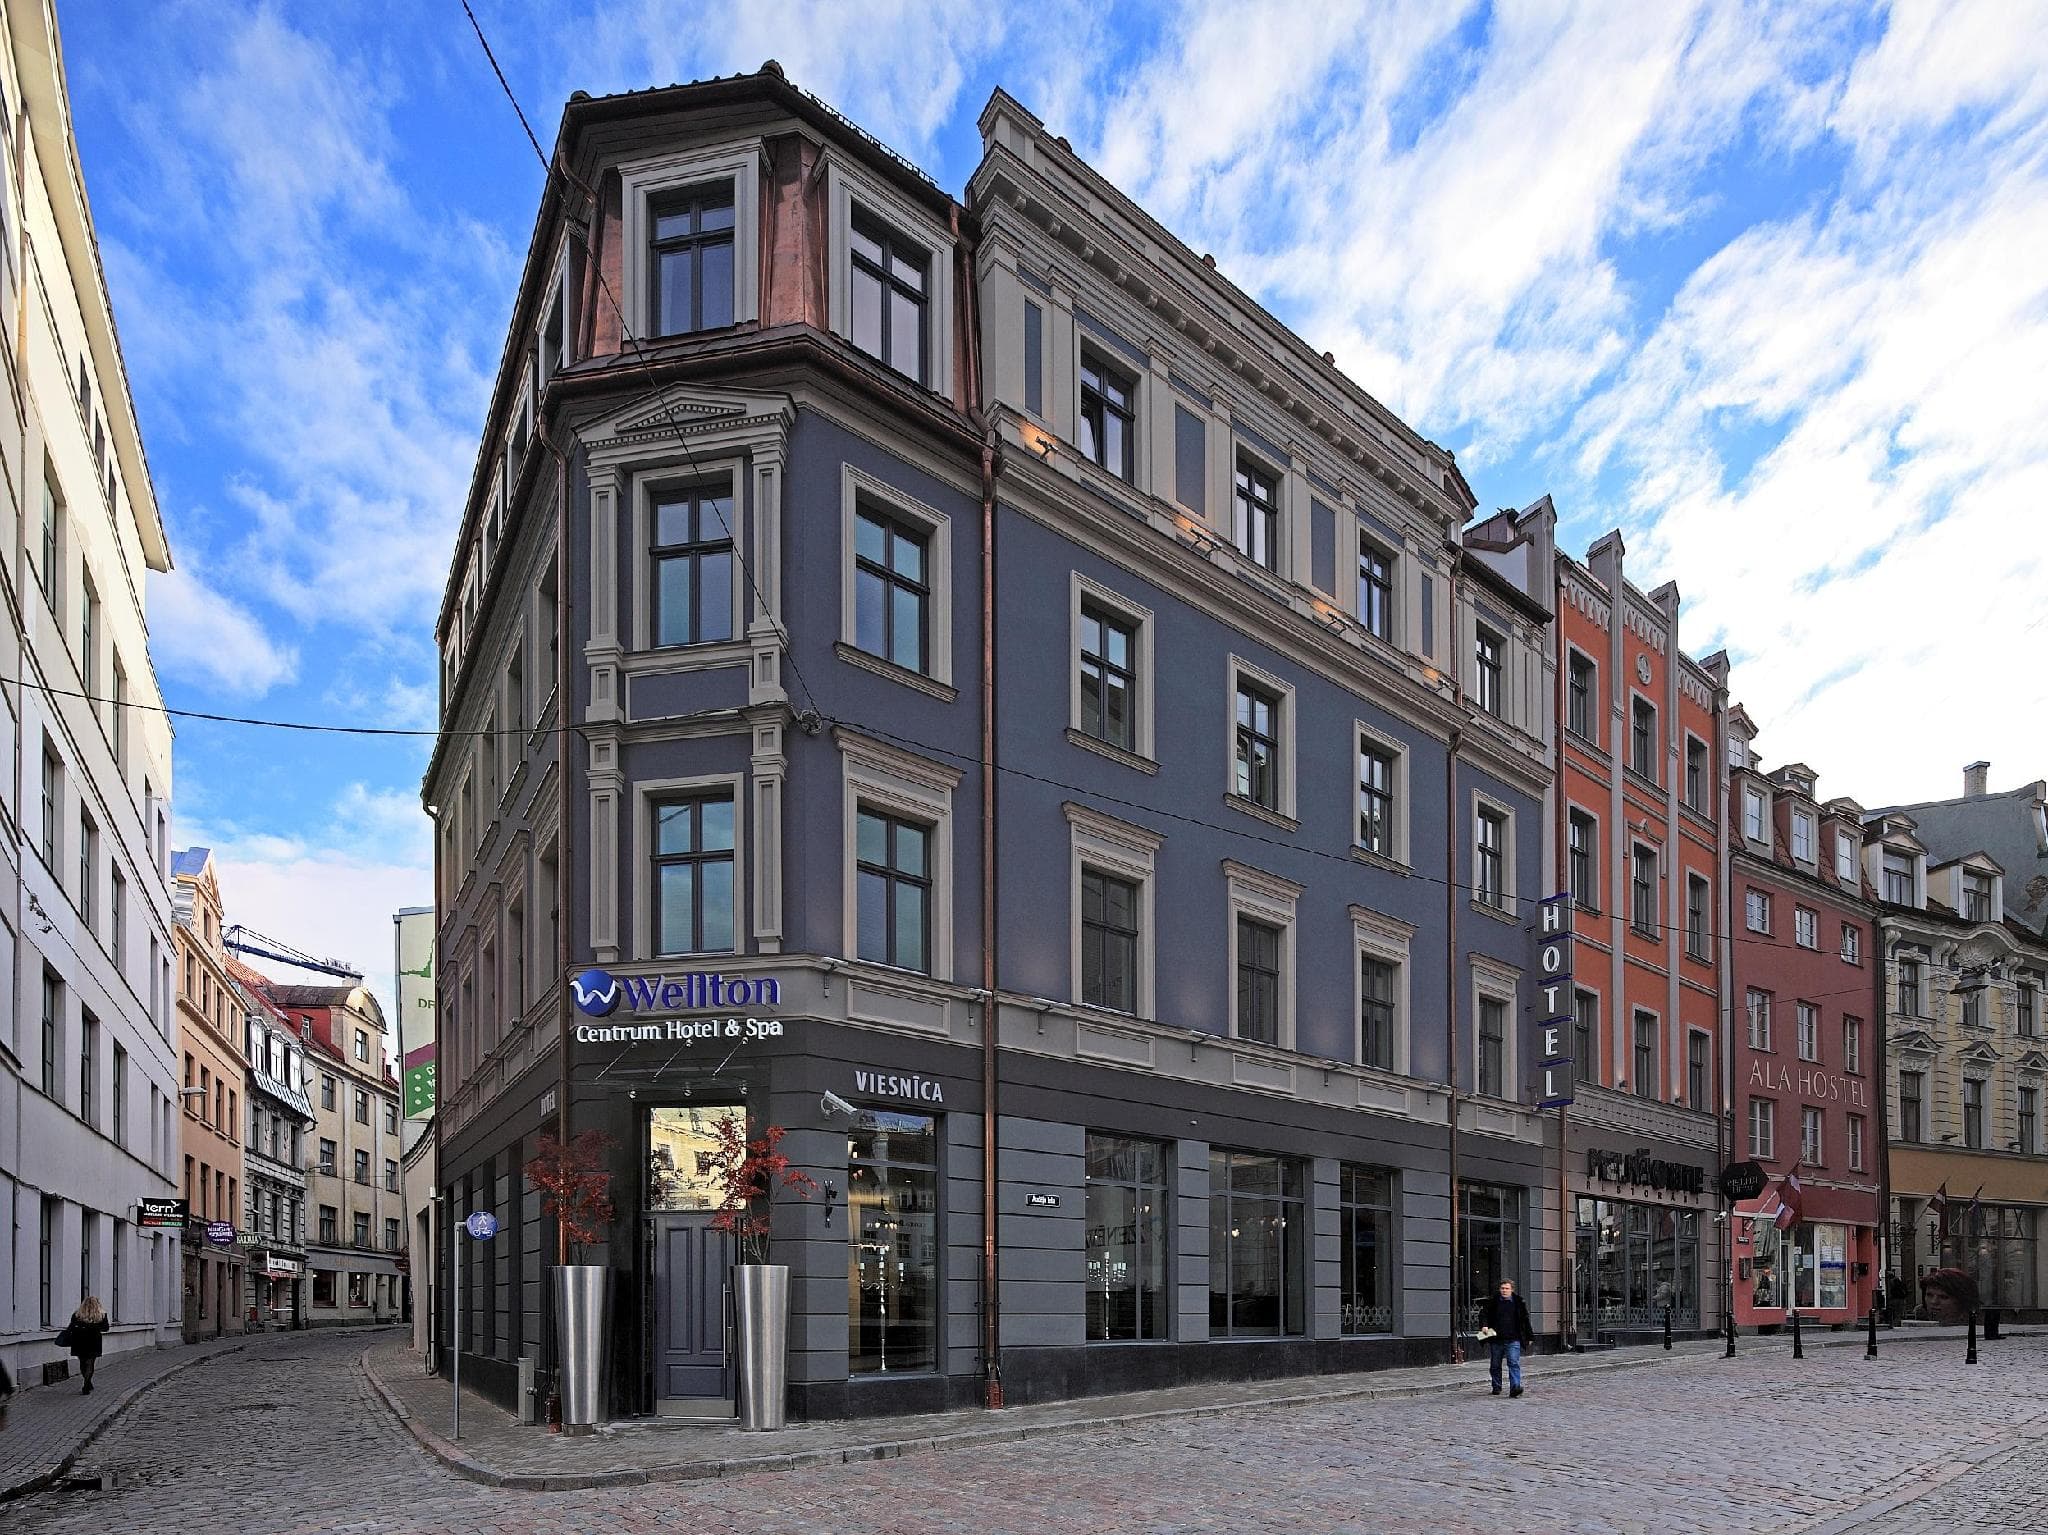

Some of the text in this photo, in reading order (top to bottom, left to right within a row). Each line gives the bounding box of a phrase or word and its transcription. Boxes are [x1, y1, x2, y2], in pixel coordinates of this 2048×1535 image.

[620, 972, 781, 1010] Wellton
[1543, 903, 1560, 1098] HOTEL
[576, 1018, 783, 1042] Centrum Hotel & Spa
[855, 1071, 944, 1103] VIESNĪCA
[1750, 1059, 1868, 1108] ALA HOSTEL
